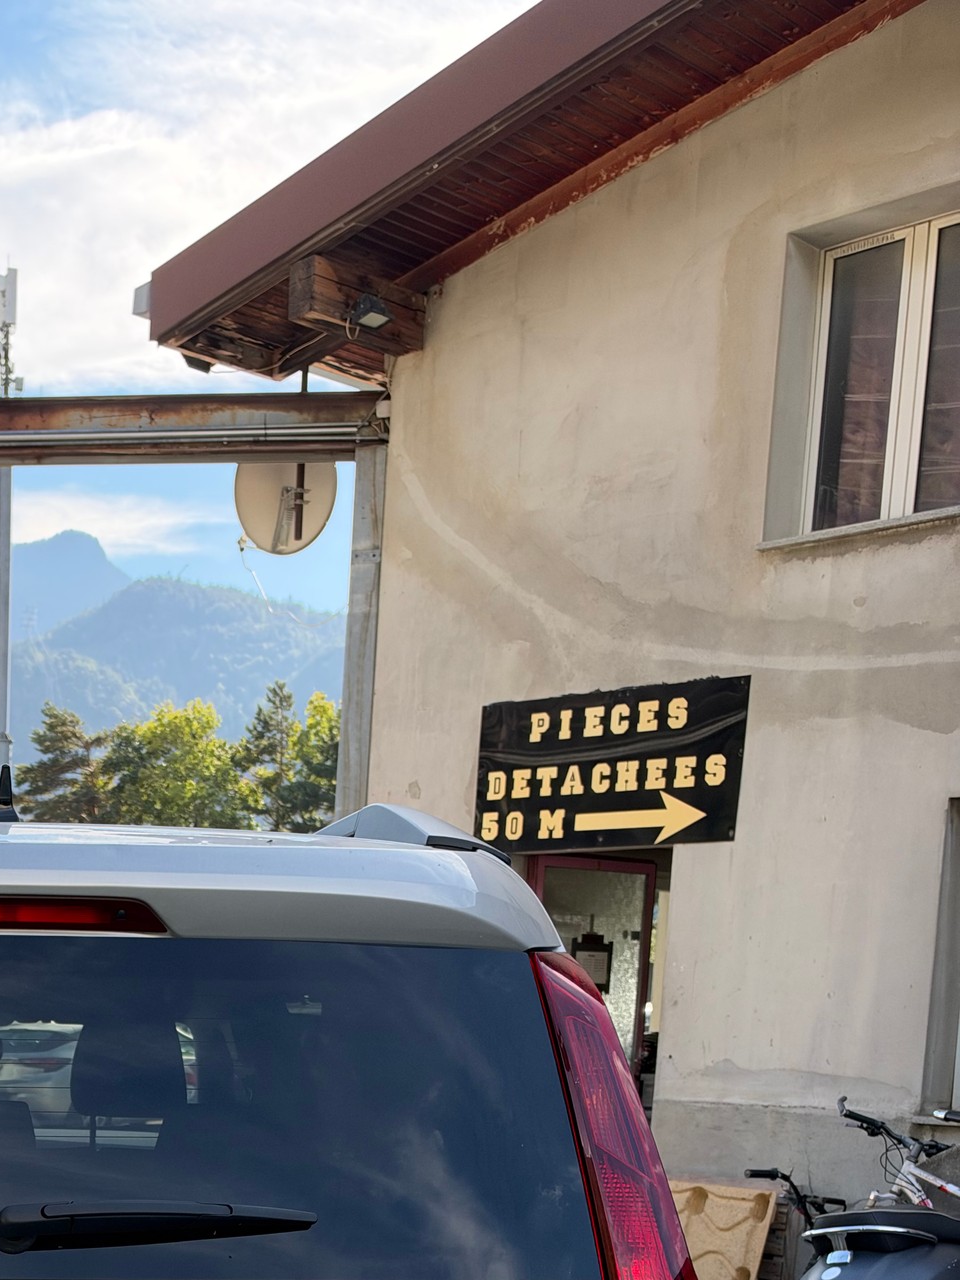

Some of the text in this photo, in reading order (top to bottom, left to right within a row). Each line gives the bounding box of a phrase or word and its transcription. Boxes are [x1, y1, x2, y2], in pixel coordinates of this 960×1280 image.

[528, 697, 689, 743] PIECES
[486, 753, 727, 801] DETACHEES
[480, 808, 566, 841] 50 M
